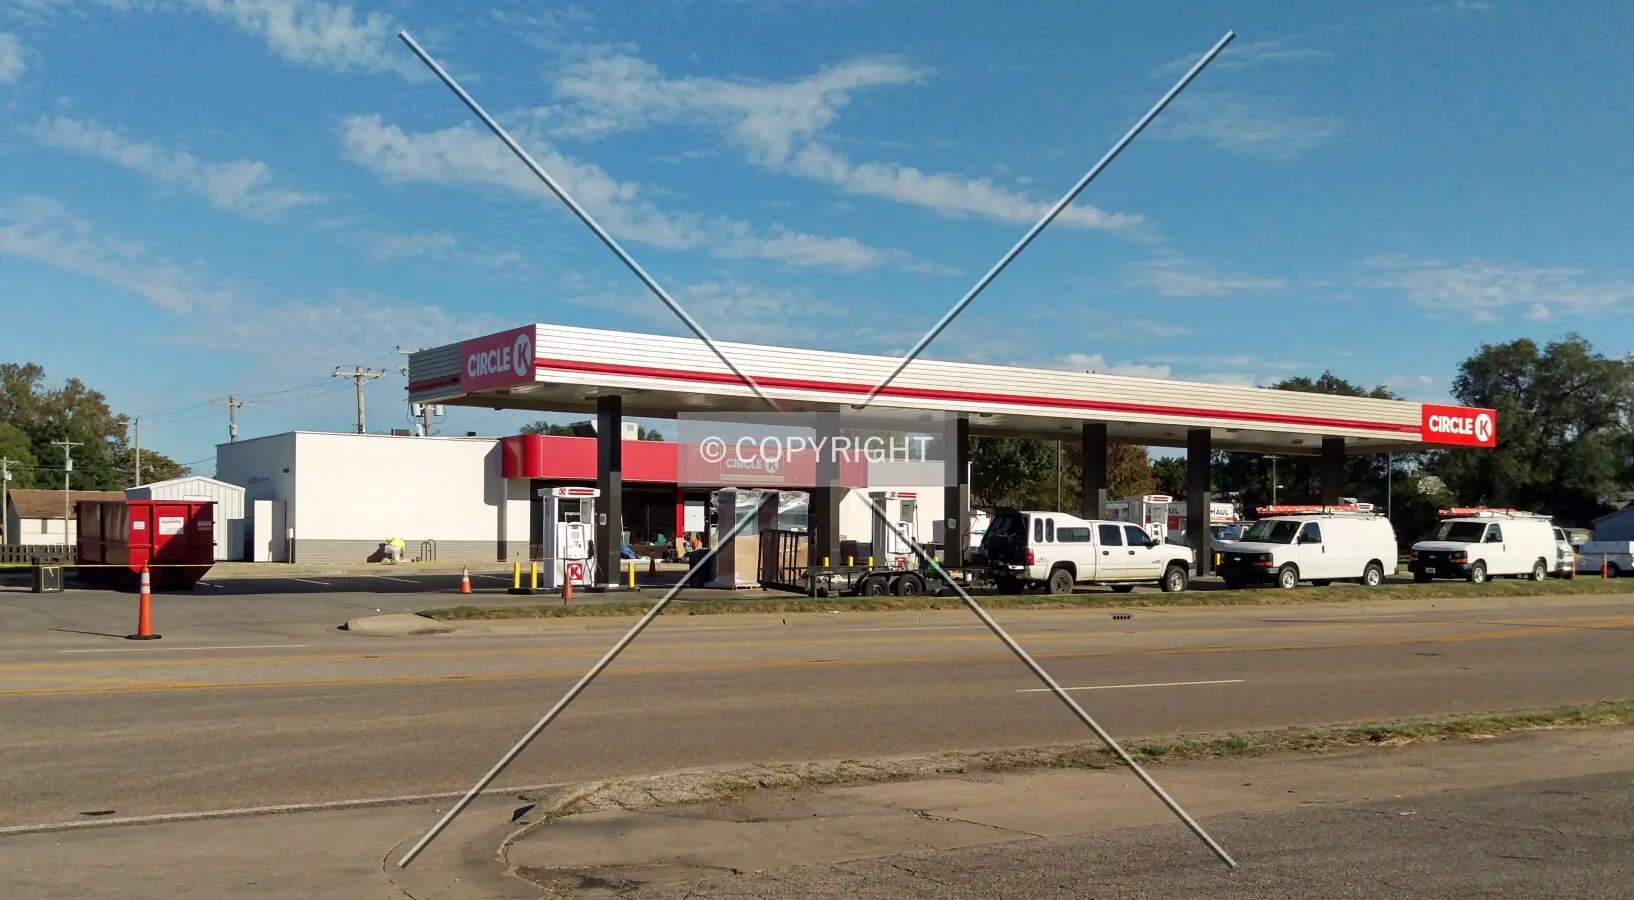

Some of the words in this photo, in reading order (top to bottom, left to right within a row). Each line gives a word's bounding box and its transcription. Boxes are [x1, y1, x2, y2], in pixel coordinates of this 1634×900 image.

[468, 346, 511, 378] CIRCLE
[516, 339, 531, 375] K
[1428, 414, 1473, 435] CIRCLE
[1477, 417, 1492, 440] K
[725, 457, 763, 469] CIRCLE
[766, 459, 780, 473] K
[569, 565, 582, 579] K
